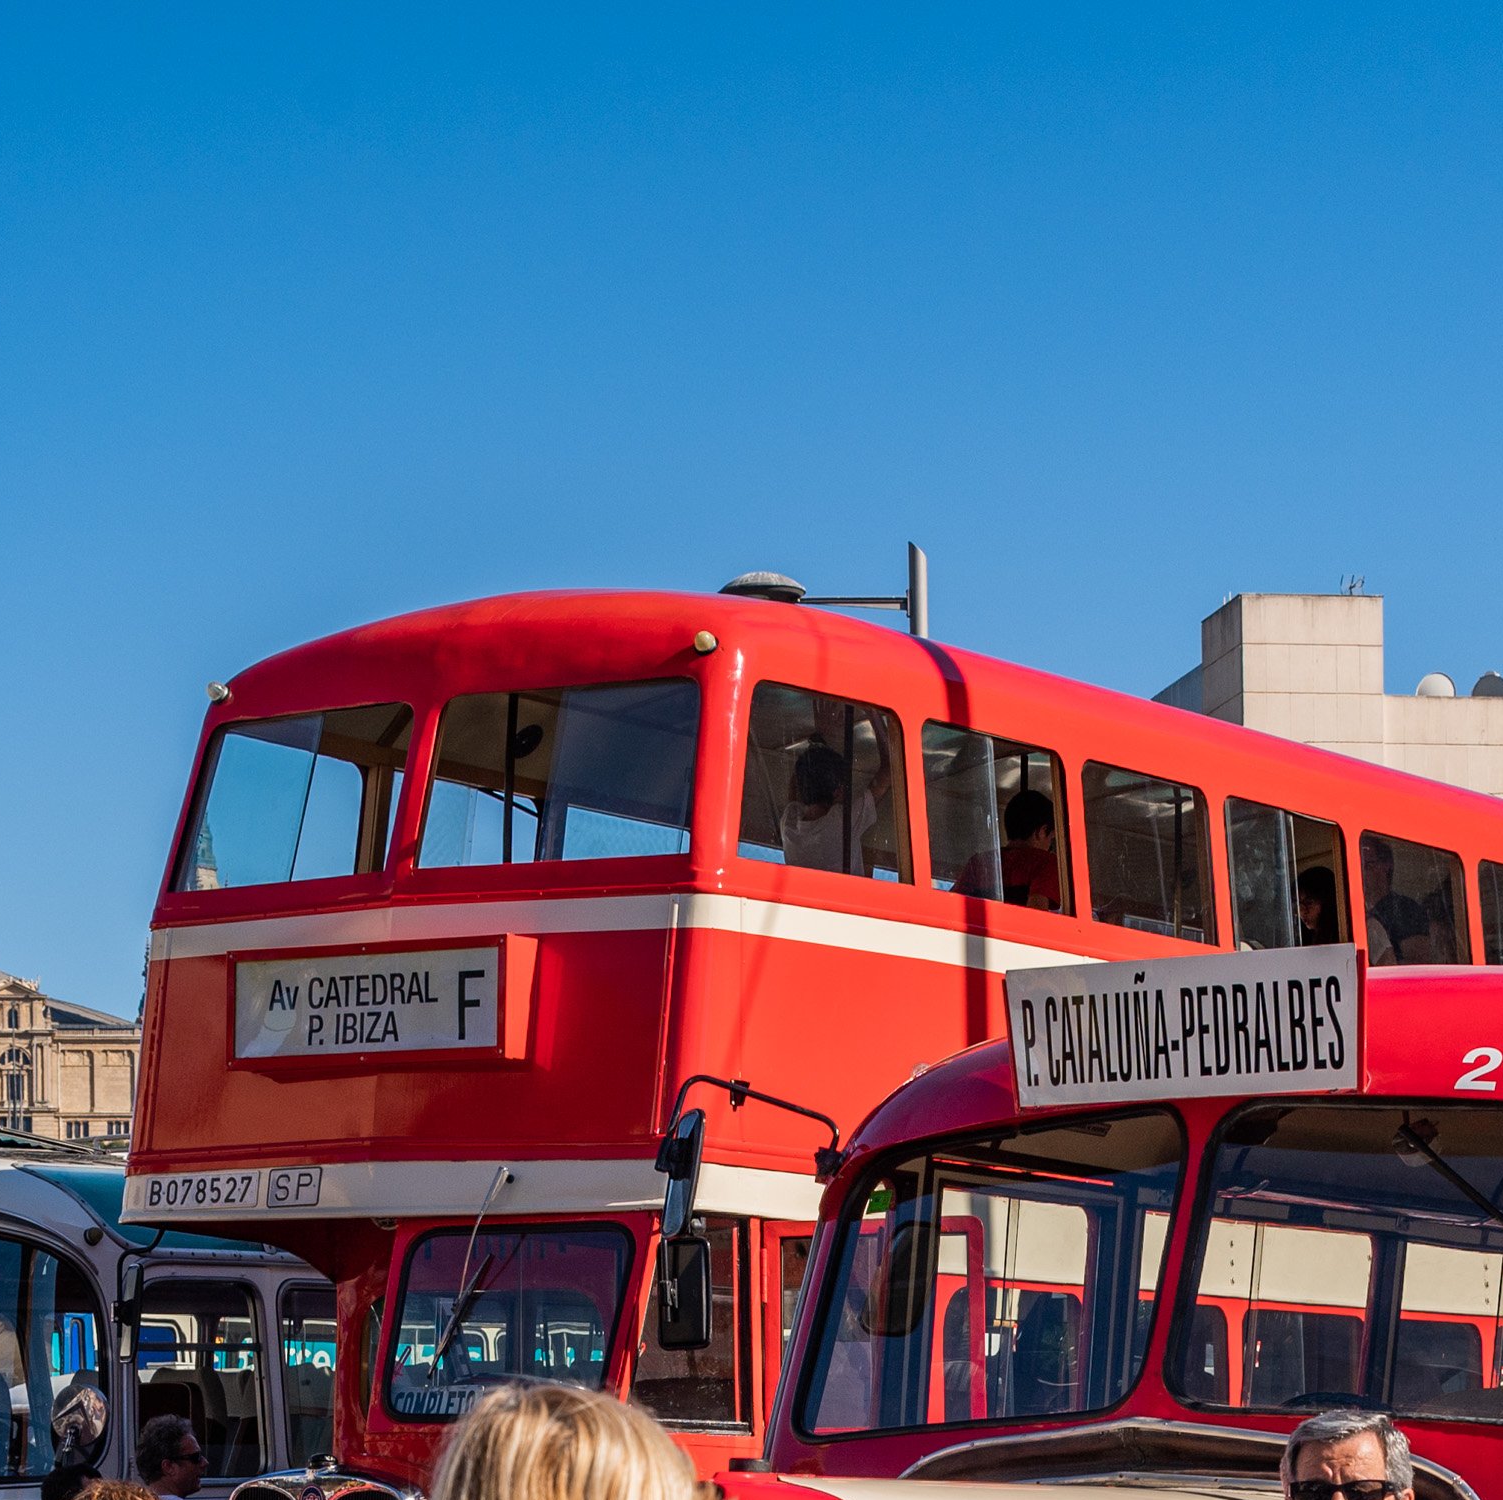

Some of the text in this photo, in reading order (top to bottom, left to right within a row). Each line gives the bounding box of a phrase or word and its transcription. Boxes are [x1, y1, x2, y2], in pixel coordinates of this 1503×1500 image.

[268, 969, 486, 1041] Av CATEDRAL F
[306, 1010, 400, 1047] P. IBIZA
[1021, 971, 1346, 1088] P. CATALUÑA-PEDRALBES
